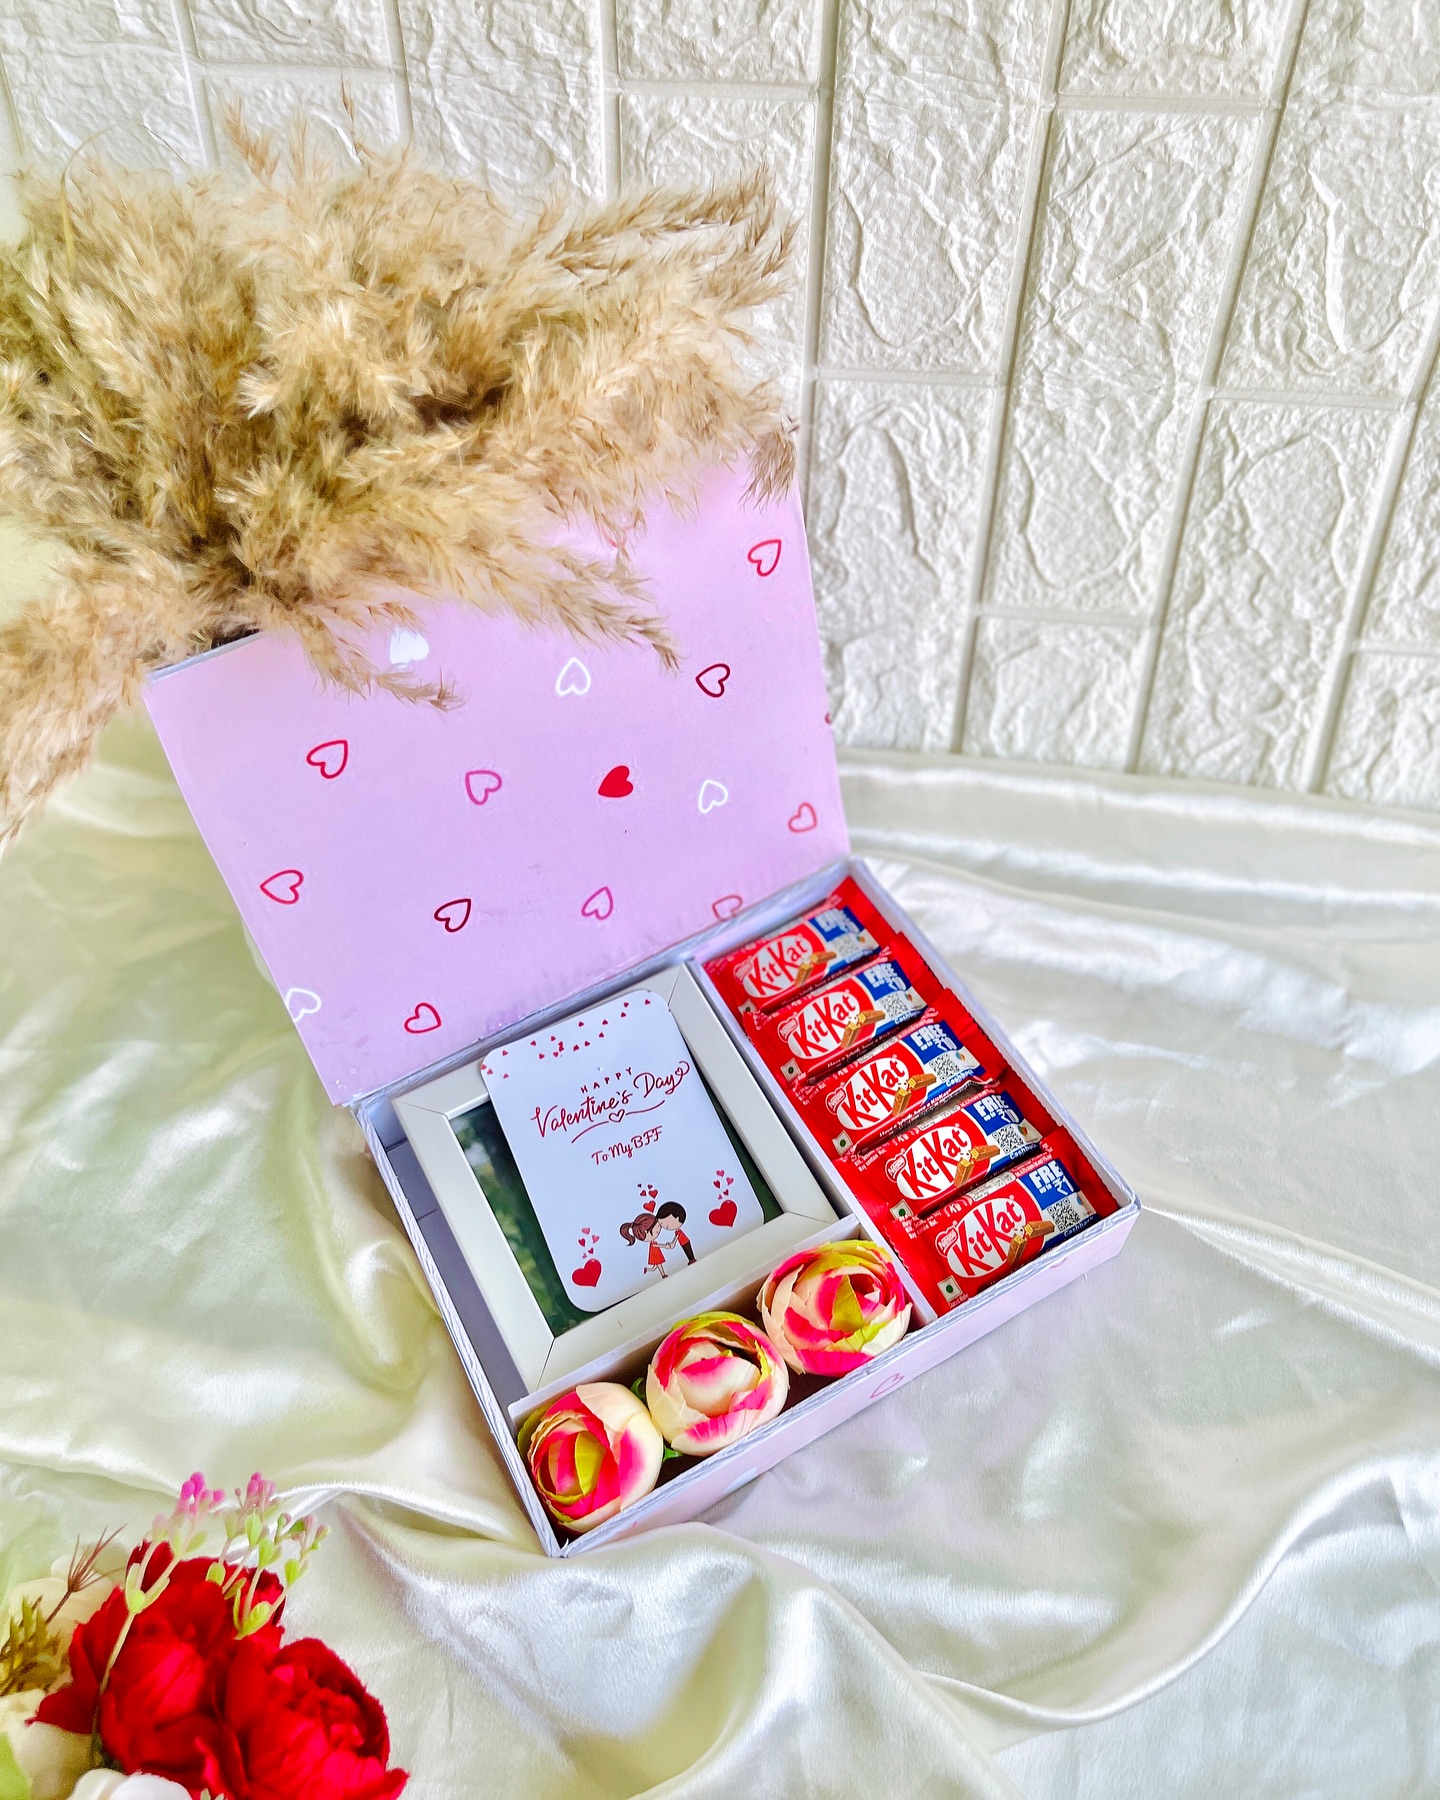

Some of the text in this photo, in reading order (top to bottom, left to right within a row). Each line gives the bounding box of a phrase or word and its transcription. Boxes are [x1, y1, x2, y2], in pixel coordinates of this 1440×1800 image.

[748, 939, 808, 995] KitKat
[793, 995, 856, 1057] KitKat
[531, 1061, 690, 1137] Valentine's Day
[580, 1067, 632, 1093] HAPPY
[841, 1060, 906, 1128] KitKat
[591, 1126, 662, 1165] To My BFF
[902, 1129, 967, 1197] KitKat
[953, 1202, 1023, 1276] KitKat
